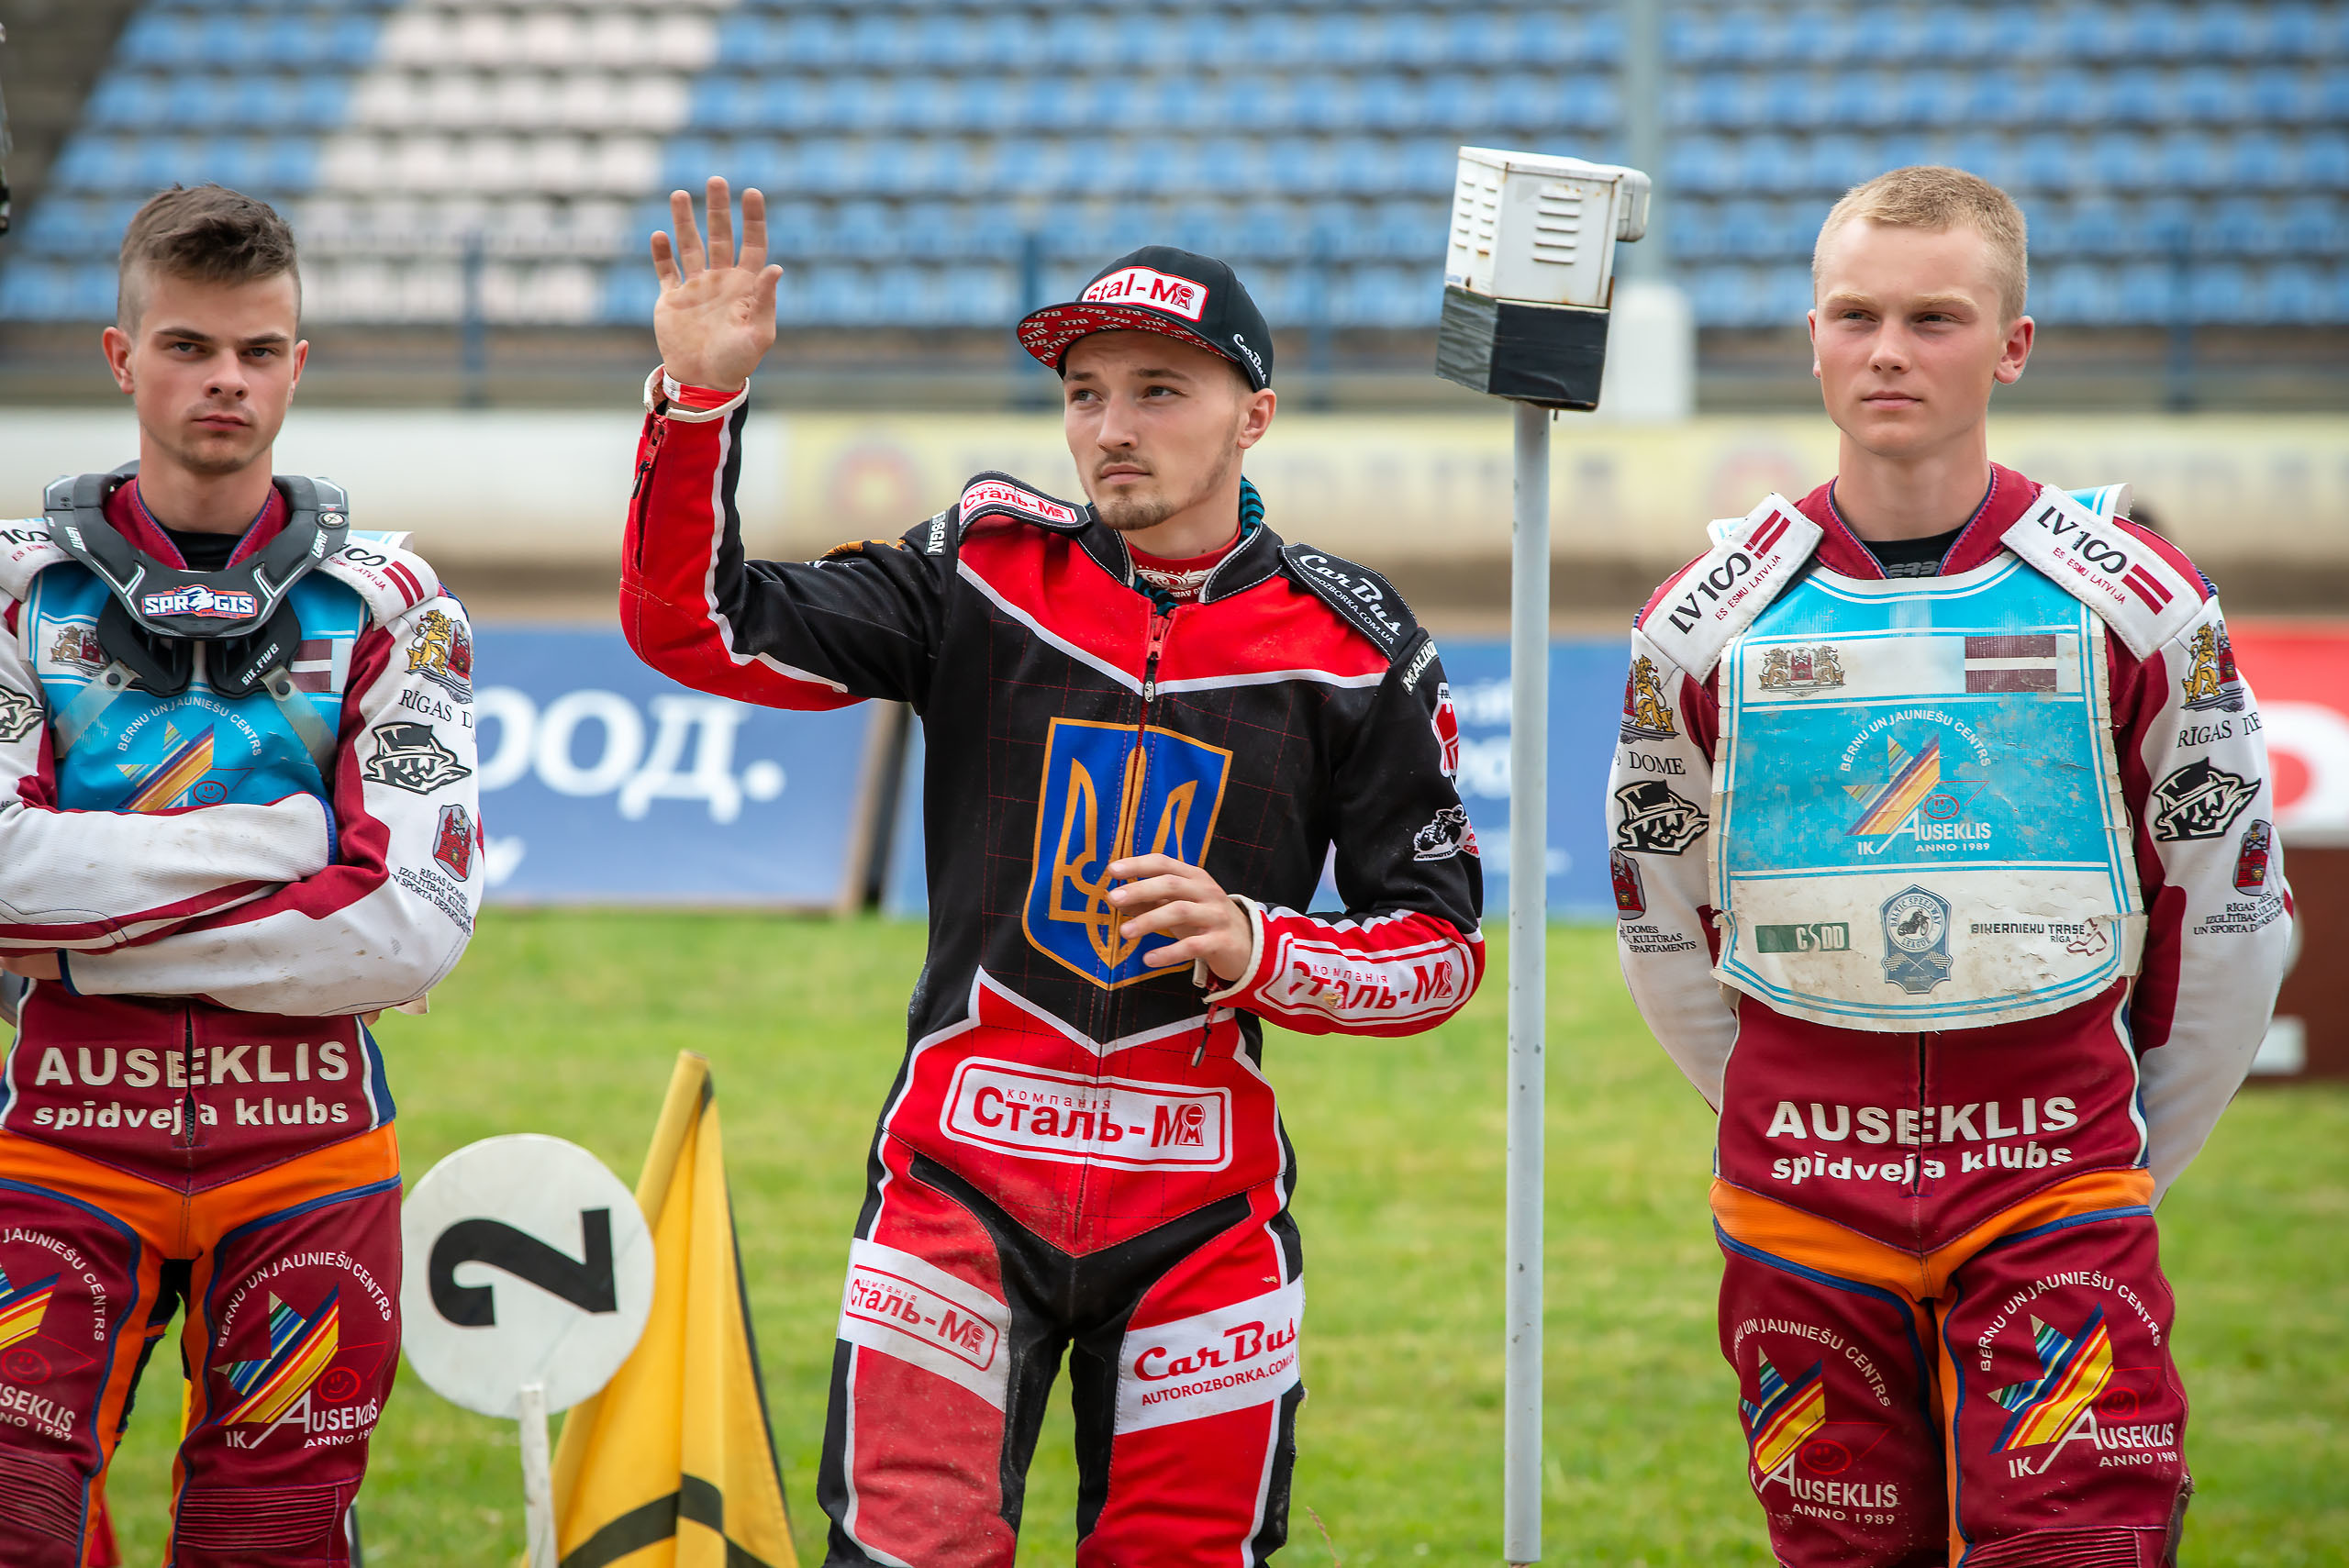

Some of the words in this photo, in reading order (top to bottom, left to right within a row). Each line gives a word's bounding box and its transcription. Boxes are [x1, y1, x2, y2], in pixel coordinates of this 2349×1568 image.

[1233, 333, 1267, 384] CarBus
[352, 567, 386, 591] LATVIJA
[1715, 606, 1729, 621] ES
[1728, 587, 1749, 608] ESMU
[1749, 554, 1781, 588] LATVIJA
[2053, 547, 2066, 560] ES
[2066, 557, 2089, 578] ESMU
[2090, 573, 2126, 606] LATVIJA
[1292, 558, 1395, 645] AUTOROZBORKA.COM.UA
[1299, 554, 1402, 637] CarBus
[400, 688, 453, 722] RĪGAS
[117, 714, 150, 751] BĒRNU
[150, 705, 169, 717] UN
[170, 696, 229, 717] JAUNIEŠU
[229, 714, 262, 756] CENTRS
[1840, 730, 1870, 772] BĒRNU
[1869, 715, 1889, 731] UN
[1889, 709, 1953, 728] JAUNIEŠU
[1954, 719, 1991, 767] CENTRS
[2176, 720, 2232, 748] RĪGAS
[1629, 751, 1687, 775] DOME
[1857, 840, 1876, 855] IK
[1876, 806, 1992, 854] AUSEKLIS
[1915, 842, 1957, 852] ANNO
[1963, 842, 1990, 851] 1989
[400, 878, 433, 901] SPORTA
[1626, 926, 1659, 934] DOMES
[1890, 901, 1908, 928] BALTIC
[1908, 897, 1942, 926] SPEEDWAY
[2047, 923, 2086, 936] TRASE
[2194, 927, 2208, 935] UN
[2210, 924, 2248, 934] SPORTA
[1629, 941, 1697, 952] EPARTAMENTS
[1633, 933, 1683, 943] KULTŪRAS
[1902, 937, 1932, 949] LEAGUE
[2050, 933, 2071, 943] RĪGA
[1313, 964, 1388, 984] компанія
[35, 1041, 350, 1089] AUSEKLIS
[33, 1100, 218, 1136] spīdveja
[235, 1096, 350, 1127] klubs
[973, 1086, 1207, 1148] Сталь-М
[1007, 1087, 1111, 1110] компанія
[1765, 1096, 2078, 1145] AUSEKLIS
[1771, 1152, 1946, 1185] spīdveja
[1961, 1141, 2074, 1173] klubs
[3, 1228, 86, 1270] JAUNIEŠU
[83, 1273, 107, 1341] CENTRS
[428, 1206, 618, 1329] 2
[246, 1267, 270, 1289] UN
[272, 1251, 353, 1277] JAUNIEŠU
[352, 1263, 392, 1322] CENTRS
[1978, 1315, 2007, 1372] BĒRNU
[2004, 1292, 2028, 1315] UN
[2027, 1270, 2114, 1300] JAUNIEŠU
[2117, 1284, 2161, 1347] CENTRS
[1134, 1317, 1297, 1382] CarBus
[1743, 1318, 1759, 1335] UN
[1761, 1318, 1844, 1350] JAUNIEŠU
[1845, 1346, 1891, 1407] CENTRS
[0, 1383, 75, 1432] SEKLIS
[249, 1389, 378, 1450] AUSEKLIS
[36, 1422, 72, 1441] 1989
[226, 1430, 249, 1449] IK
[304, 1434, 354, 1449] ANNO
[2035, 1405, 2175, 1474] AUSEKLIS
[2008, 1456, 2037, 1478] IK
[2099, 1453, 2153, 1467] ANNO
[2156, 1451, 2178, 1462] 1989
[1758, 1452, 1898, 1508] AUSEKLIS
[1792, 1503, 1846, 1520] ANNO
[1855, 1514, 1896, 1525] 1989
